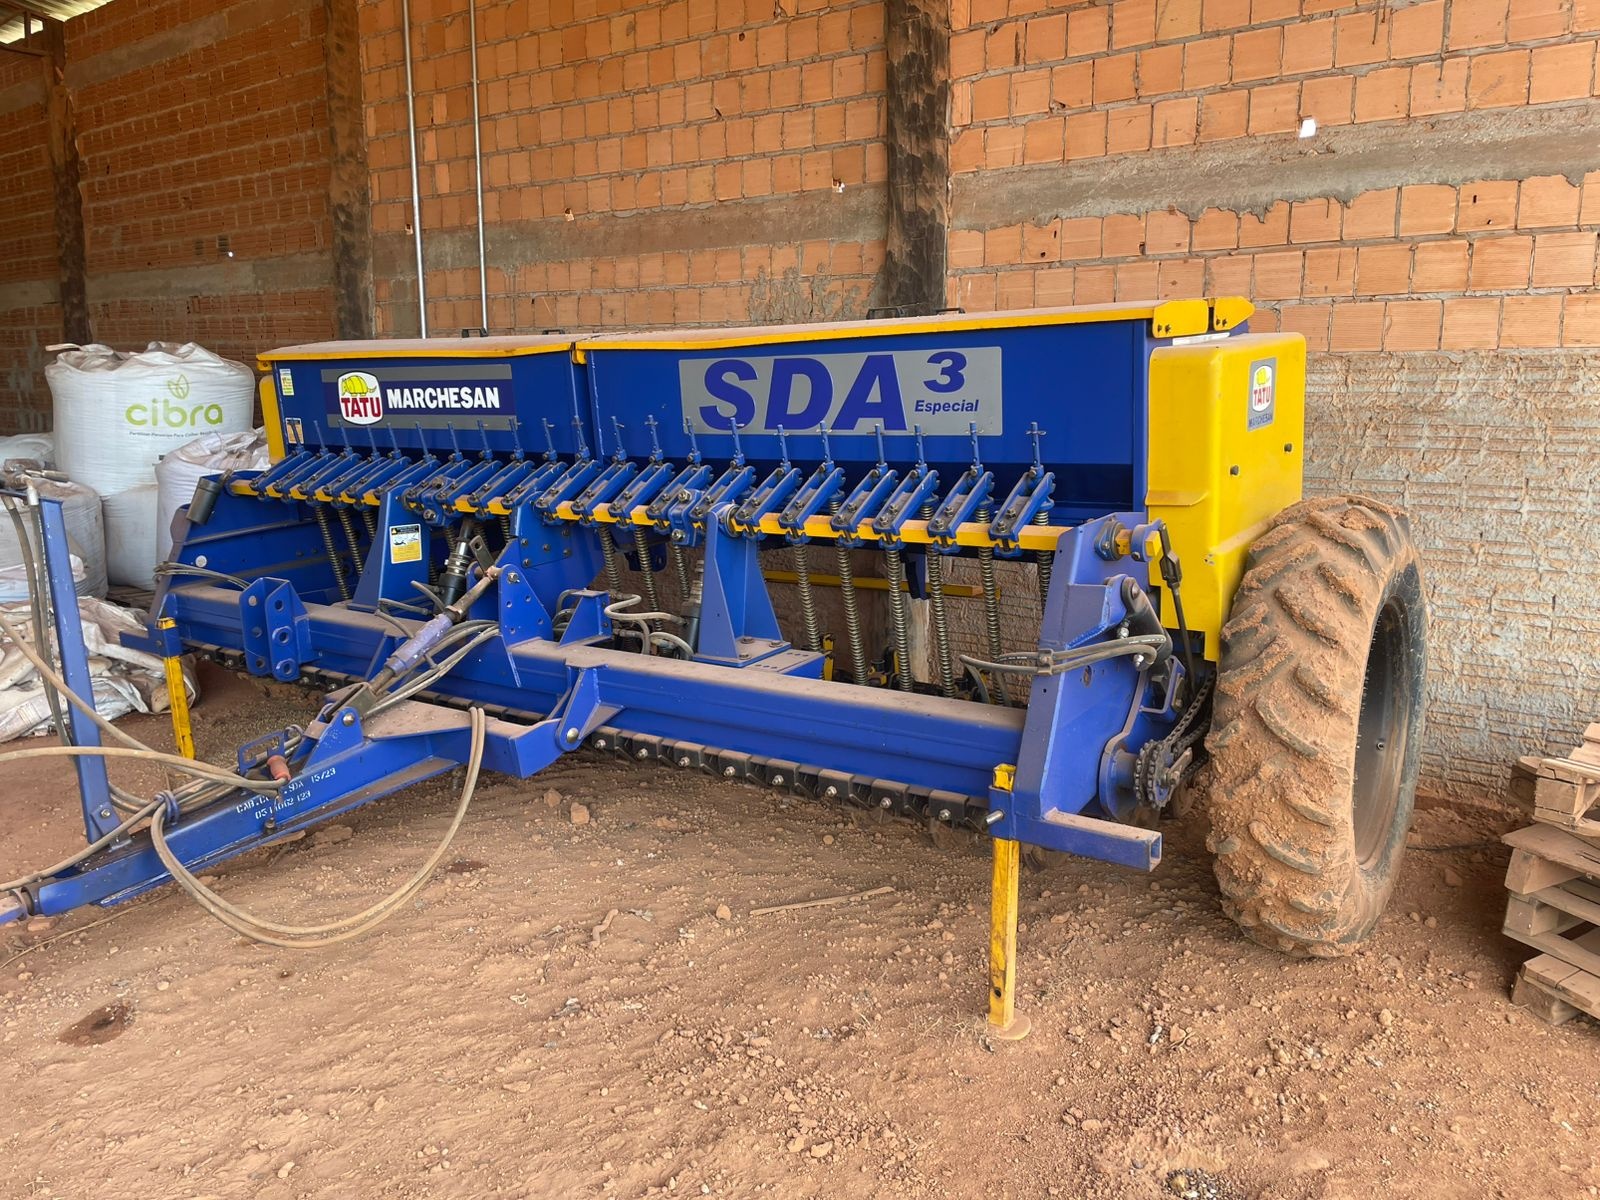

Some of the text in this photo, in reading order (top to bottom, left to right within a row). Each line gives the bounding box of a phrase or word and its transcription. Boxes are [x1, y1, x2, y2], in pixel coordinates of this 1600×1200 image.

[340, 386, 500, 418] TATU MARCHESAN
[699, 350, 968, 431] SDA 3
[1253, 386, 1273, 407] TATU
[125, 397, 223, 428] cibra
[914, 398, 980, 415] Especial
